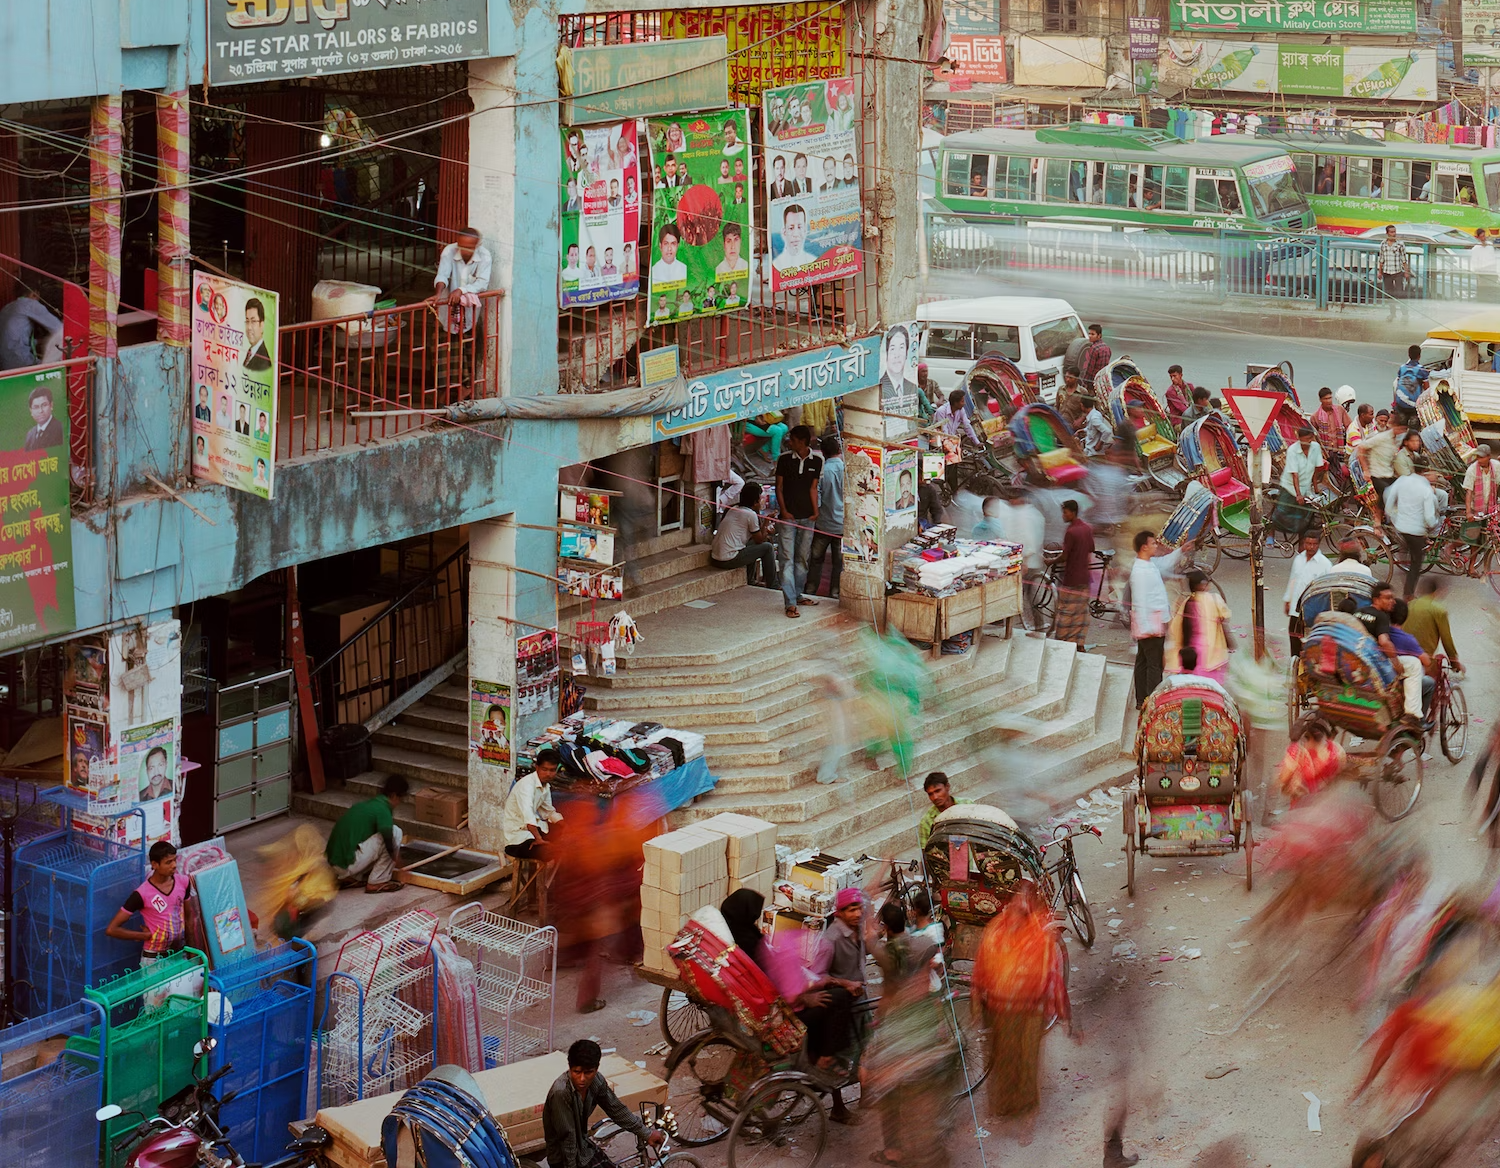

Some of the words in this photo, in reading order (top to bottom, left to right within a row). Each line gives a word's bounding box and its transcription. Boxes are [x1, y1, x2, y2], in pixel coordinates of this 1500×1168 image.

[1287, 0, 1317, 19] ক্লথ
[1130, 18, 1160, 30] IELTS
[1283, 20, 1310, 31] Mitaly
[1312, 20, 1337, 29] Cloth
[1338, 20, 1363, 29] Store
[216, 39, 257, 59] THE
[259, 34, 310, 55] STAR
[316, 27, 387, 49] TAILORS
[391, 26, 402, 42] &
[406, 19, 478, 41] FABRICS
[1130, 33, 1160, 45] MBA
[281, 55, 308, 74] সুপার
[311, 51, 344, 70] মার্কেট
[578, 58, 612, 96] সিটি
[1355, 78, 1393, 96] CLEMON
[713, 368, 782, 413] ডেন্টাল
[787, 343, 872, 392] সার্জারী
[11, 459, 37, 483] দেখো
[38, 456, 59, 477] আজ
[1, 518, 31, 541] তোমায়
